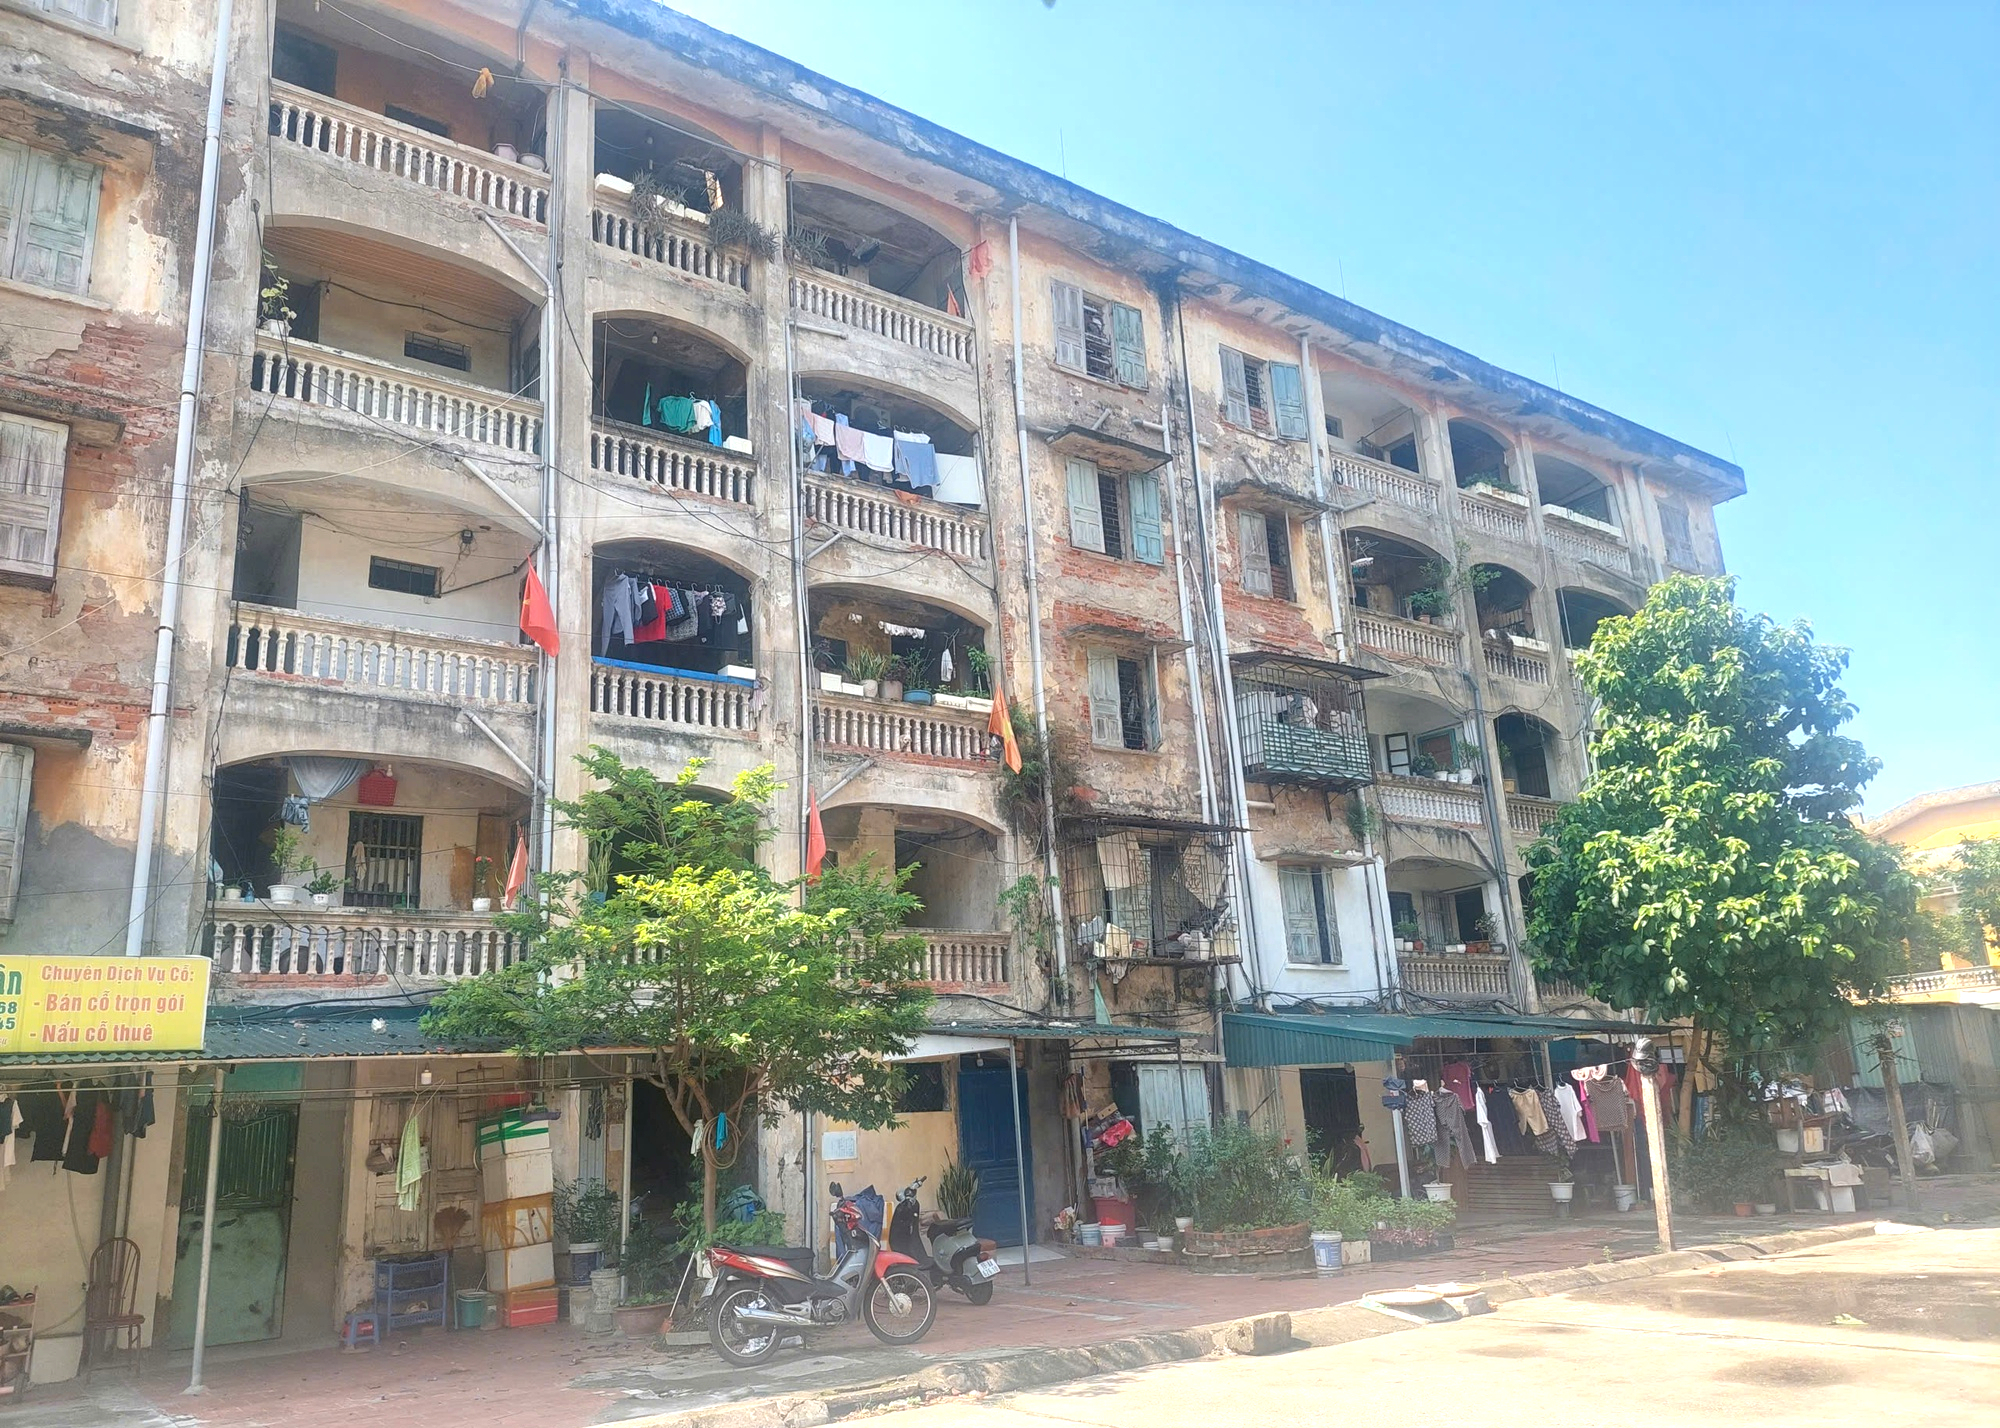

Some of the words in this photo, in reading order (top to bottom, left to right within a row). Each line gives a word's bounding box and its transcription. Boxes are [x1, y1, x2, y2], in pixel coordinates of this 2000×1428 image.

[41, 965, 102, 982] Chuyên
[106, 965, 142, 984] Dịch
[147, 966, 165, 985] Vụ
[46, 993, 82, 1011] Bán
[87, 990, 110, 1011] cỗ
[115, 994, 151, 1015] trọn
[156, 993, 184, 1013] gói
[42, 1020, 79, 1042] Nấu
[85, 1020, 107, 1042] cỗ
[113, 1023, 153, 1041] thuê
